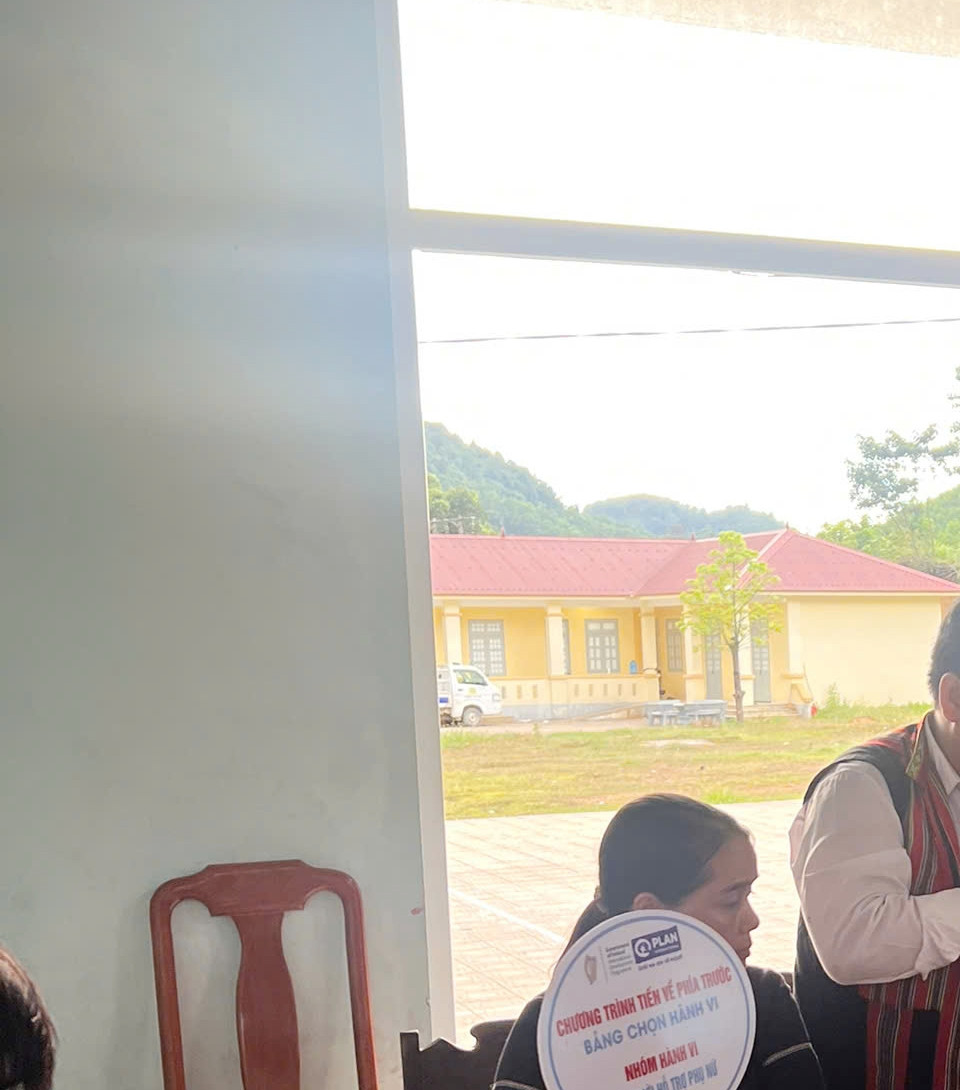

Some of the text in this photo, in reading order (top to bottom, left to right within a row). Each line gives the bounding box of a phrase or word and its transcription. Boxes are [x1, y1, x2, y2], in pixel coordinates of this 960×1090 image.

[652, 931, 679, 949] PLAN
[603, 997, 637, 1021] TRÌNH
[584, 996, 719, 1055] BẢNG CHỌN HÀNH VI
[624, 1041, 699, 1081] NHÓM HÀNH VI
